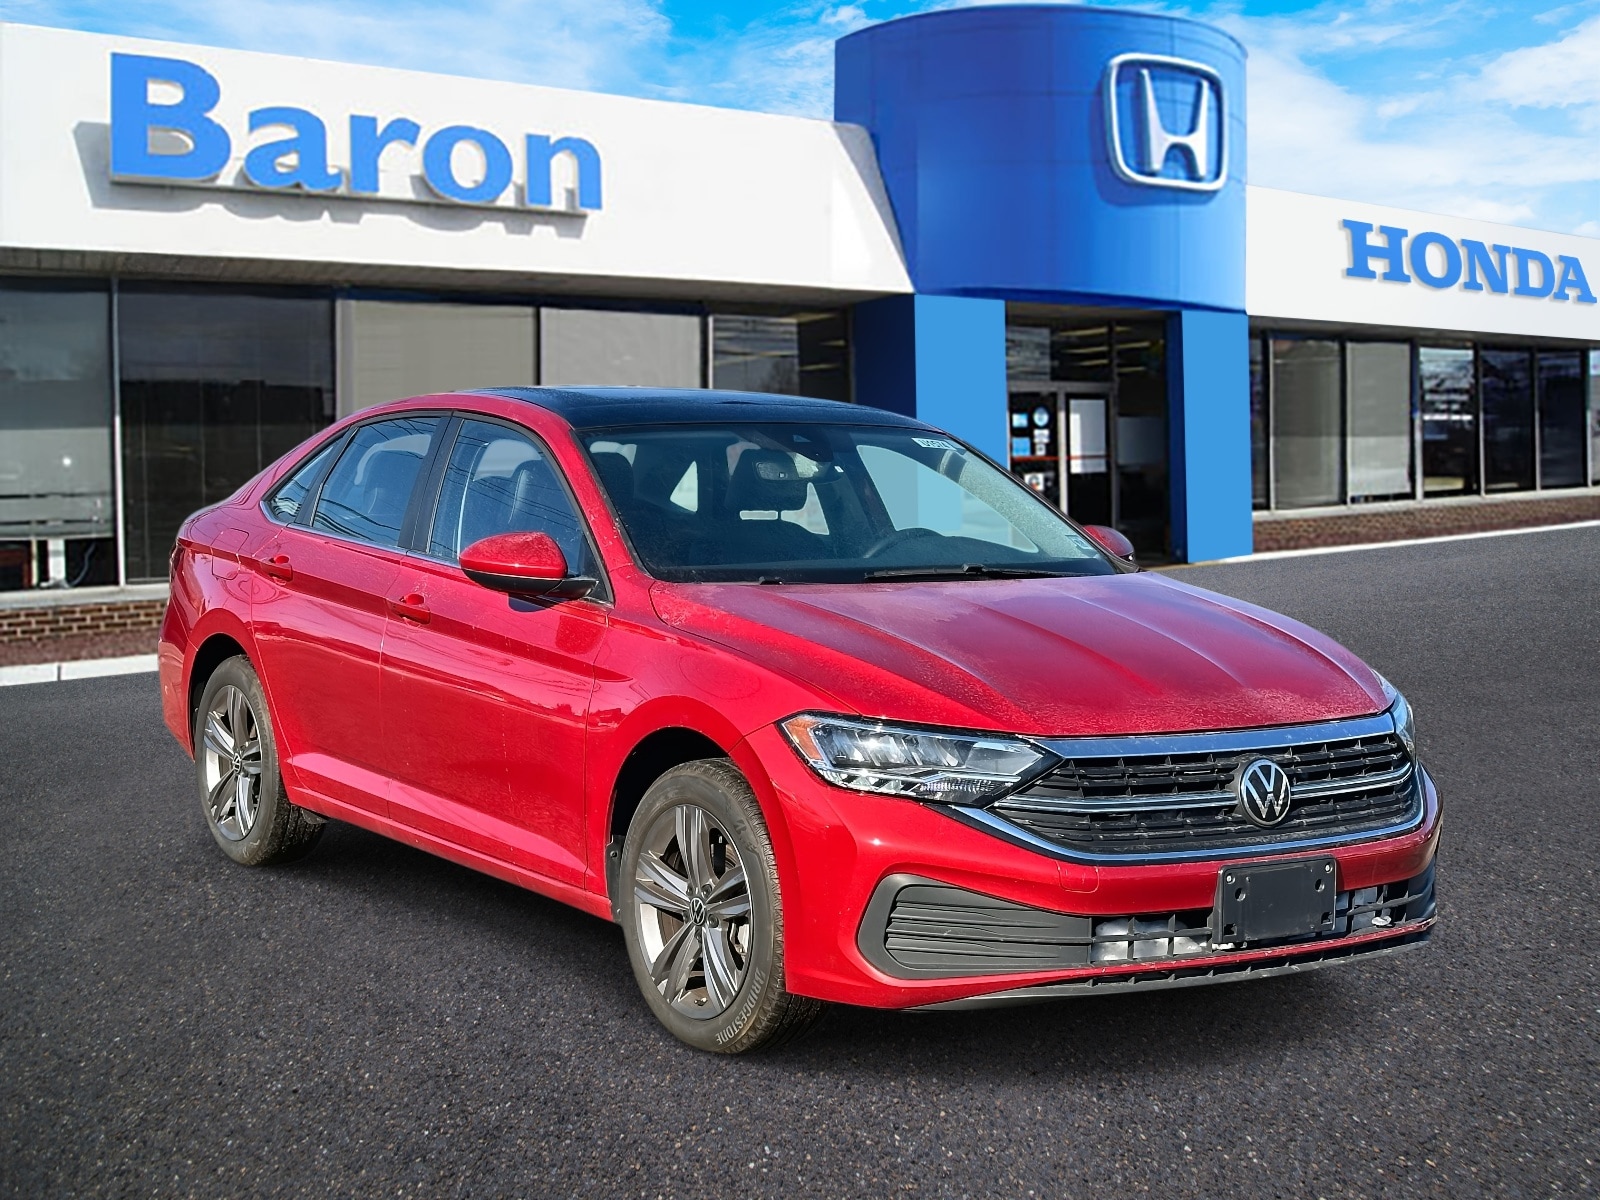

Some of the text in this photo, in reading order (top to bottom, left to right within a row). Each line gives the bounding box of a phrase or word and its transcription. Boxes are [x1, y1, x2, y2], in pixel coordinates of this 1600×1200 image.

[110, 53, 603, 211] Baron
[1342, 219, 1597, 303] HONDA
[715, 966, 767, 1045] BRIDGESTONE
